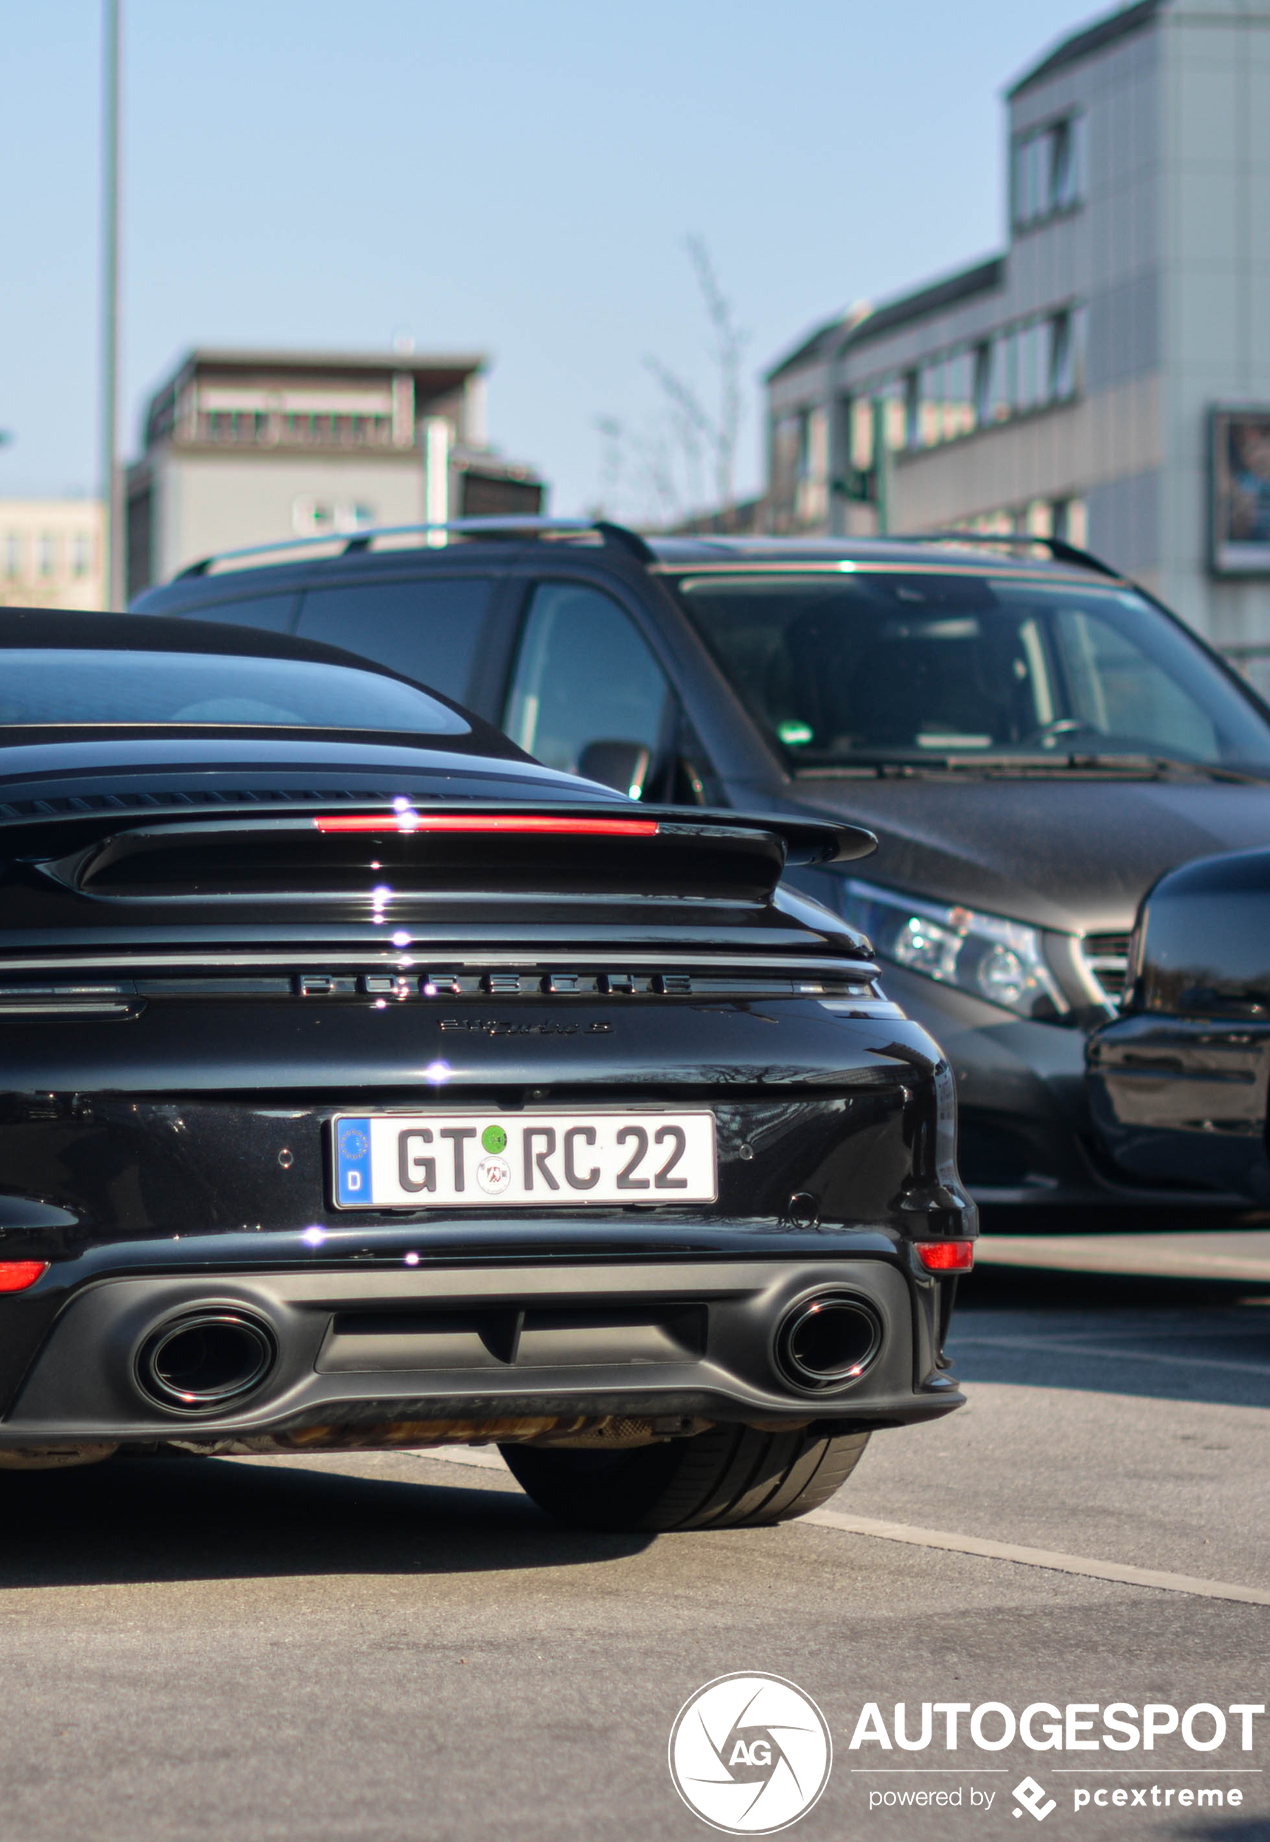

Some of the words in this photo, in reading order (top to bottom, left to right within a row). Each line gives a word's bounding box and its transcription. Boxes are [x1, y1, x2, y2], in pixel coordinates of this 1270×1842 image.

[297, 973, 692, 996] PORSCHE
[398, 1127, 477, 1193] GT
[523, 1125, 601, 1191] RC
[616, 1125, 688, 1190] 22
[347, 1171, 361, 1191] D
